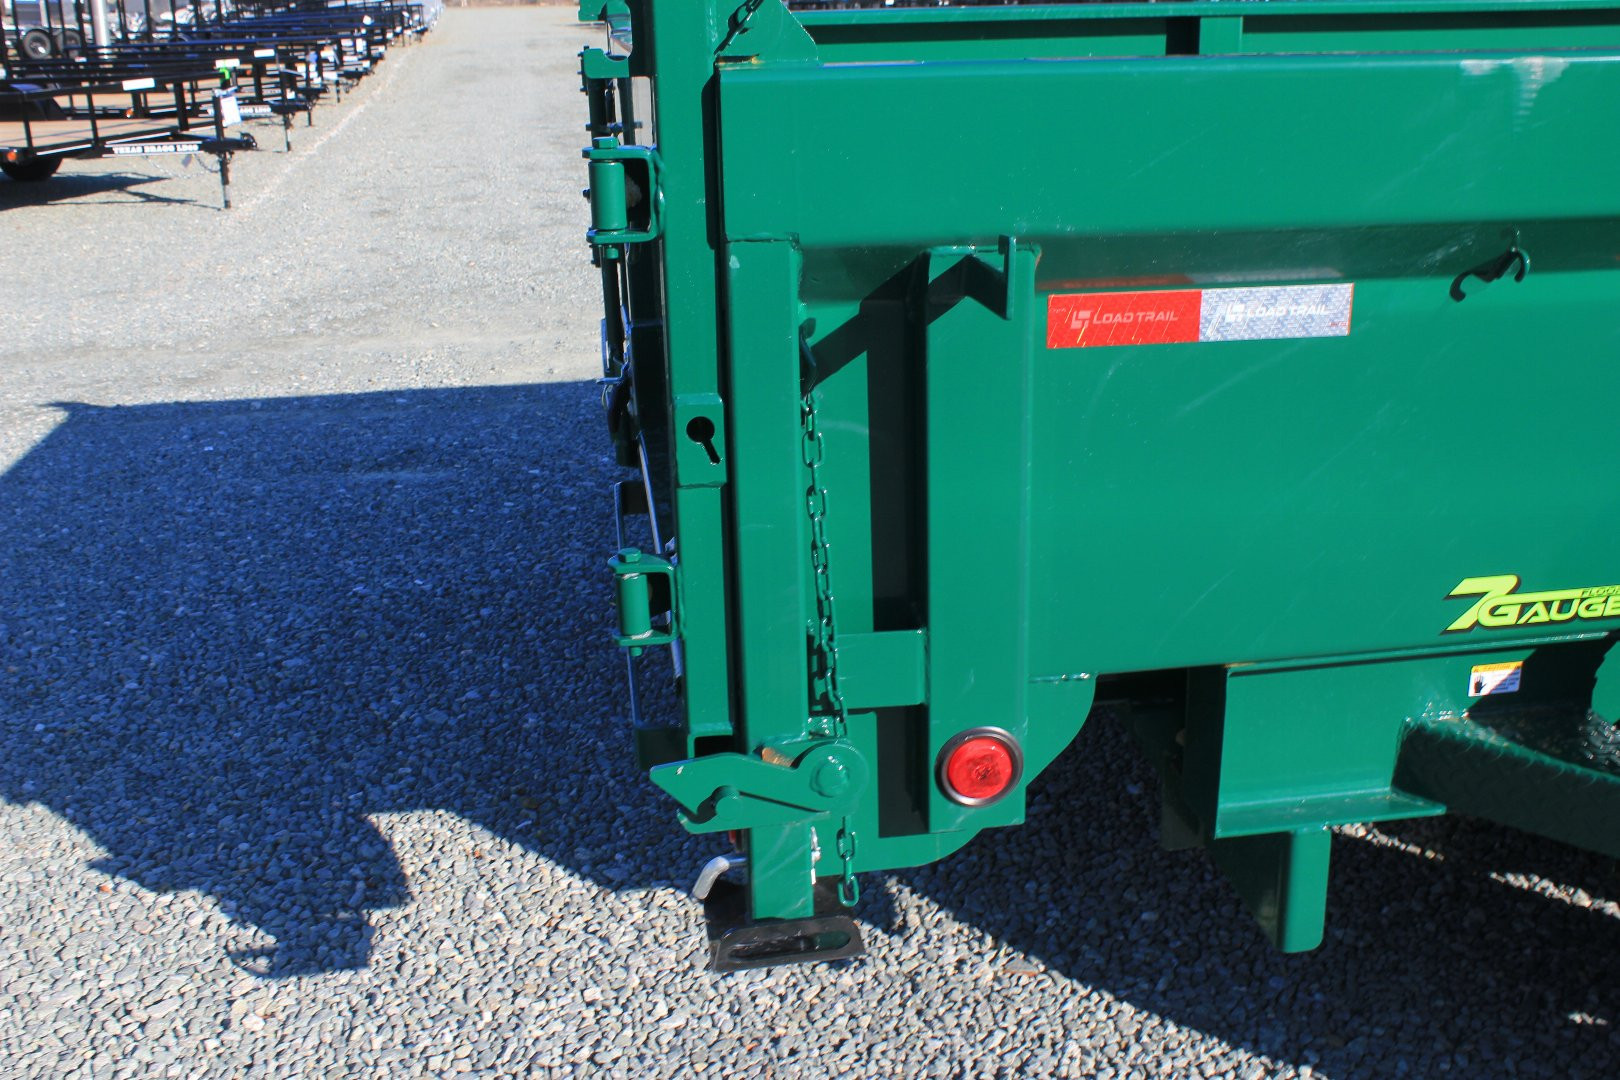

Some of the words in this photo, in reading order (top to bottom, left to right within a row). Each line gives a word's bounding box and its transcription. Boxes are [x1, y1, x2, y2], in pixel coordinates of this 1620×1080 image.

[1093, 312, 1134, 324] LOAD
[1136, 310, 1179, 323] TRAIL
[1247, 306, 1288, 317] LOAD
[1290, 304, 1330, 316] TRAIL
[1446, 574, 1518, 632] 7
[1477, 594, 1620, 628] GAUGE
